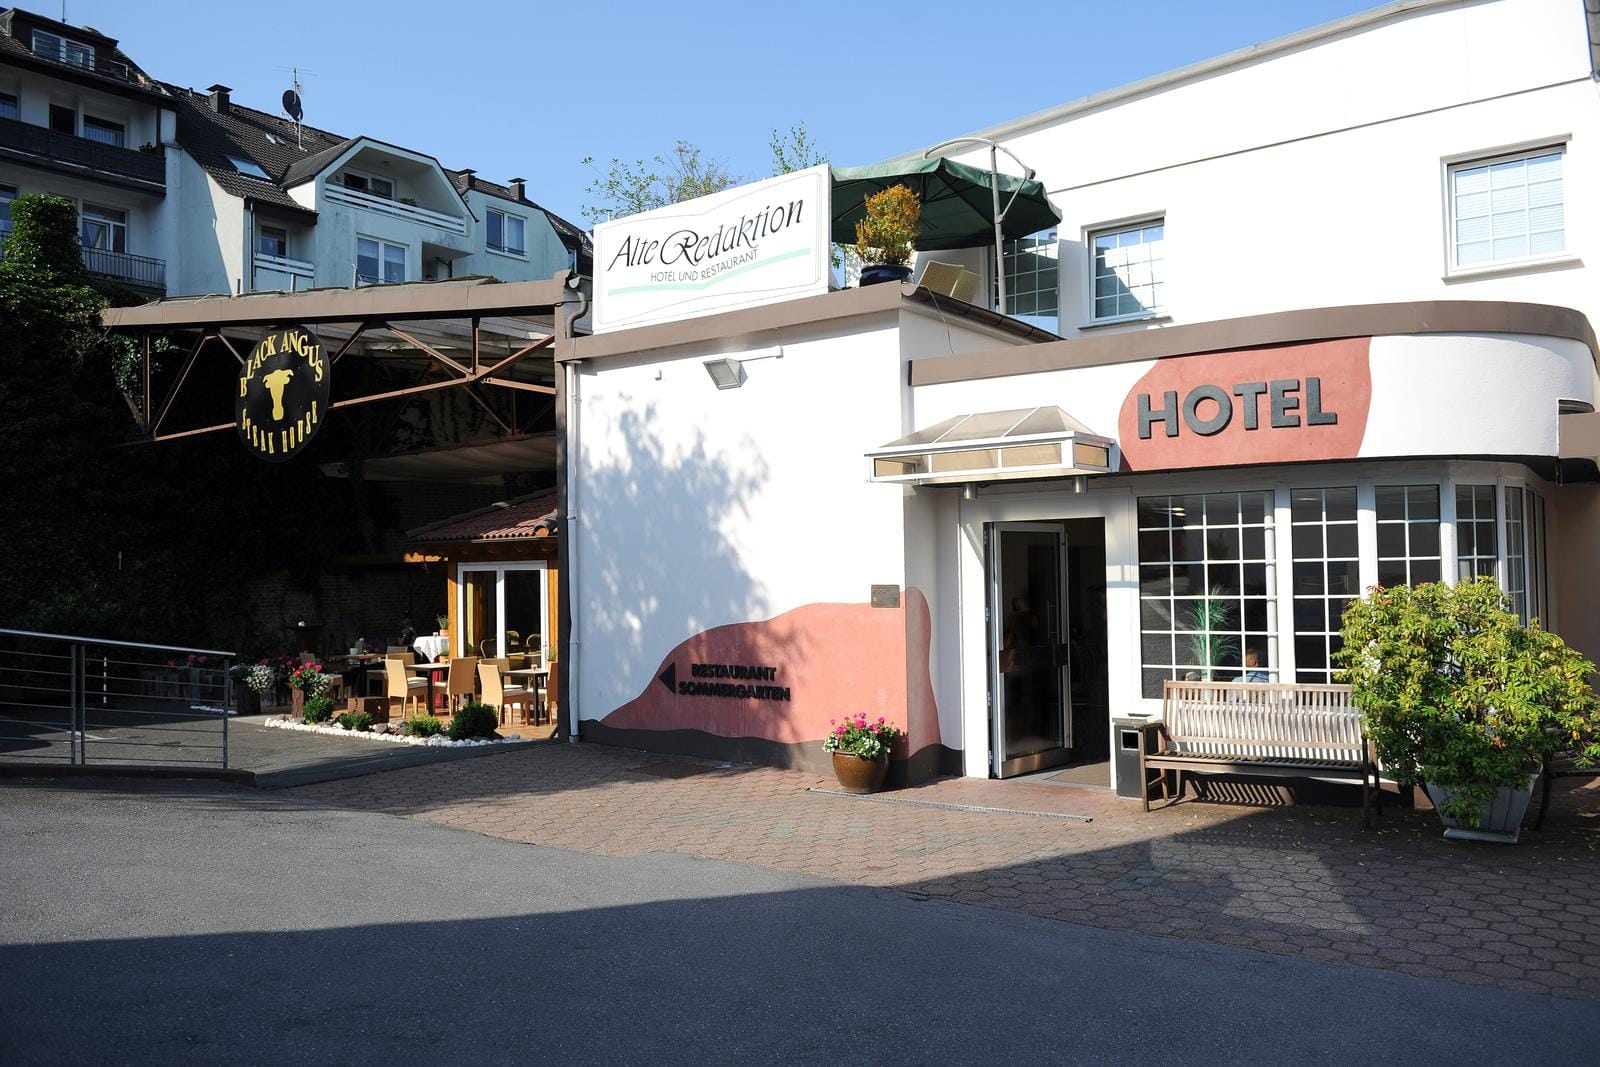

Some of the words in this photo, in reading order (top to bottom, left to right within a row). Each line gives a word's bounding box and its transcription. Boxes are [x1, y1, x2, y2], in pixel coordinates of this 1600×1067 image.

[607, 235, 659, 271] Alte
[660, 199, 804, 267] Redaktion
[650, 271, 676, 283] HOTEL
[678, 272, 699, 282] UND
[701, 249, 758, 280] RESTAURANT
[240, 334, 277, 397] BLACK
[280, 330, 323, 382] ANGUS
[242, 408, 275, 454] STEAK
[281, 400, 317, 453] HOUSE
[1137, 377, 1338, 439] HOTEL
[678, 681, 791, 702] SOMMERGARTEN
[692, 664, 777, 681] RESTAURANT
